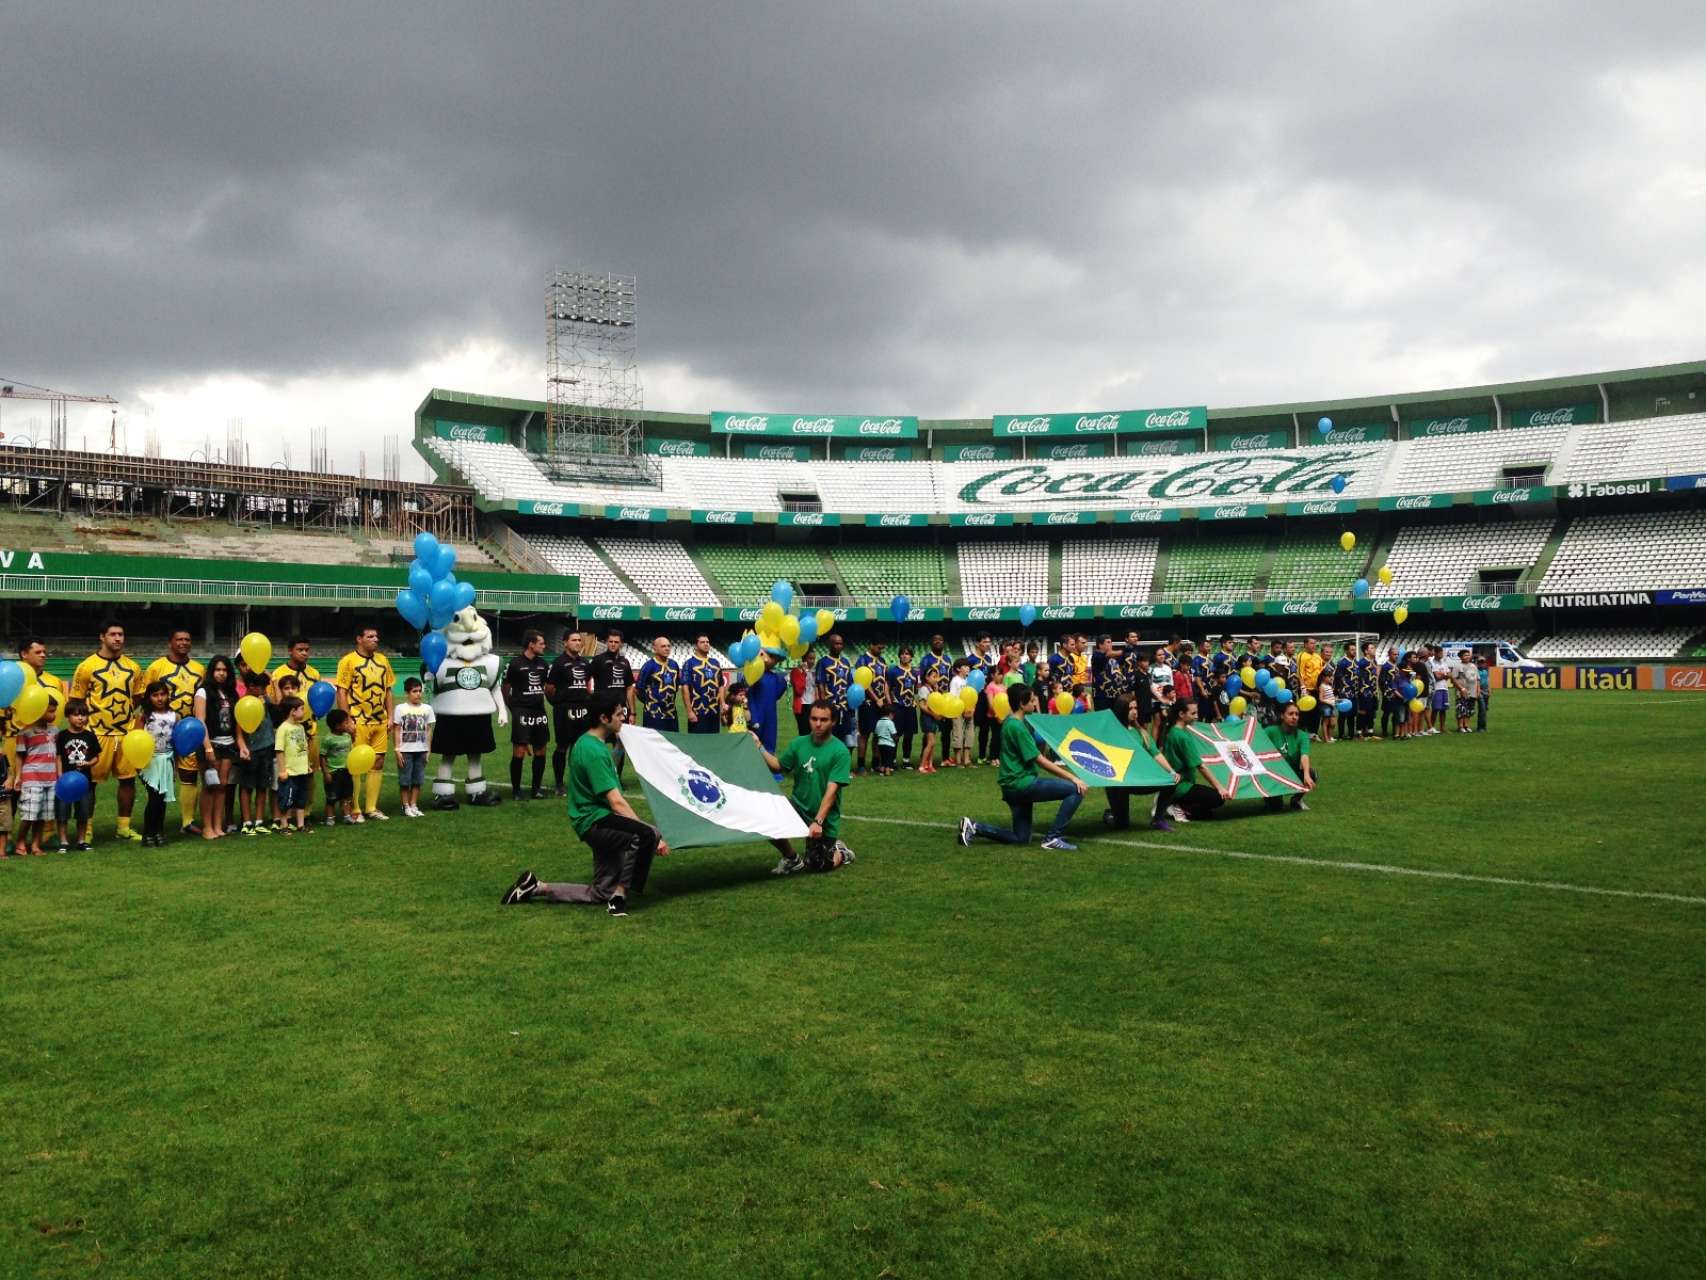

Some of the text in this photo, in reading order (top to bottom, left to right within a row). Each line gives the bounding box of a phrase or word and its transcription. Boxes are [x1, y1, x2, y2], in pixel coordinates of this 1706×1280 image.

[1586, 480, 1650, 498] Fabesul
[1540, 592, 1651, 608] NUTRILATINA
[1506, 668, 1557, 689] Itaú
[1579, 668, 1632, 690] Itaú
[1671, 671, 1706, 688] GOL
[520, 715, 548, 726] LUPO
[567, 708, 588, 719] LUP
